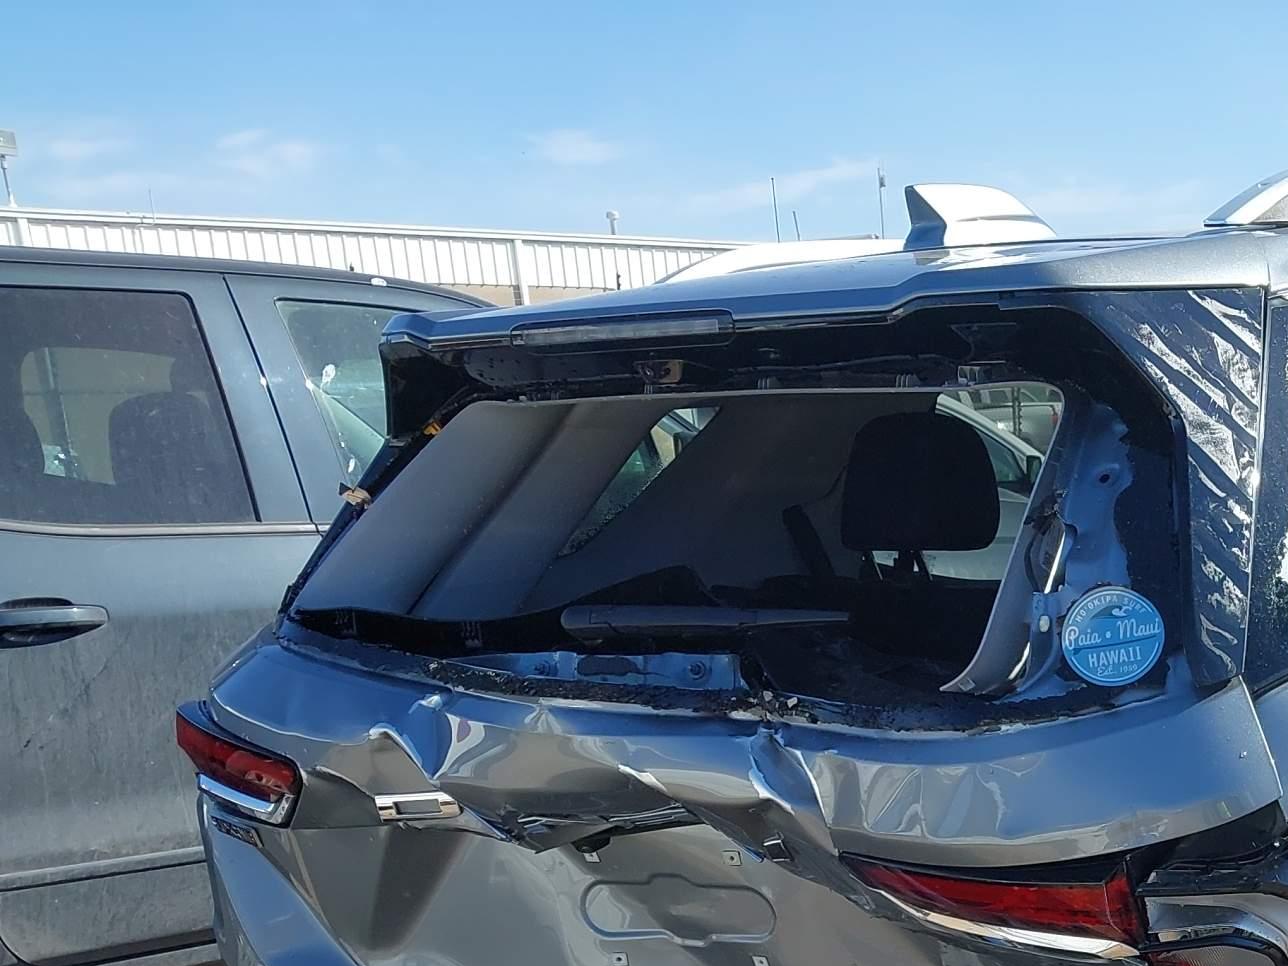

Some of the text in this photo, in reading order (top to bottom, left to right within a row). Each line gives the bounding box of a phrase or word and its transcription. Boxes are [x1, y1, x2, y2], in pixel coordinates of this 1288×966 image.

[1123, 598, 1147, 613] SURF
[1065, 617, 1162, 650] Paia Maui
[1089, 646, 1141, 667] HAWAII
